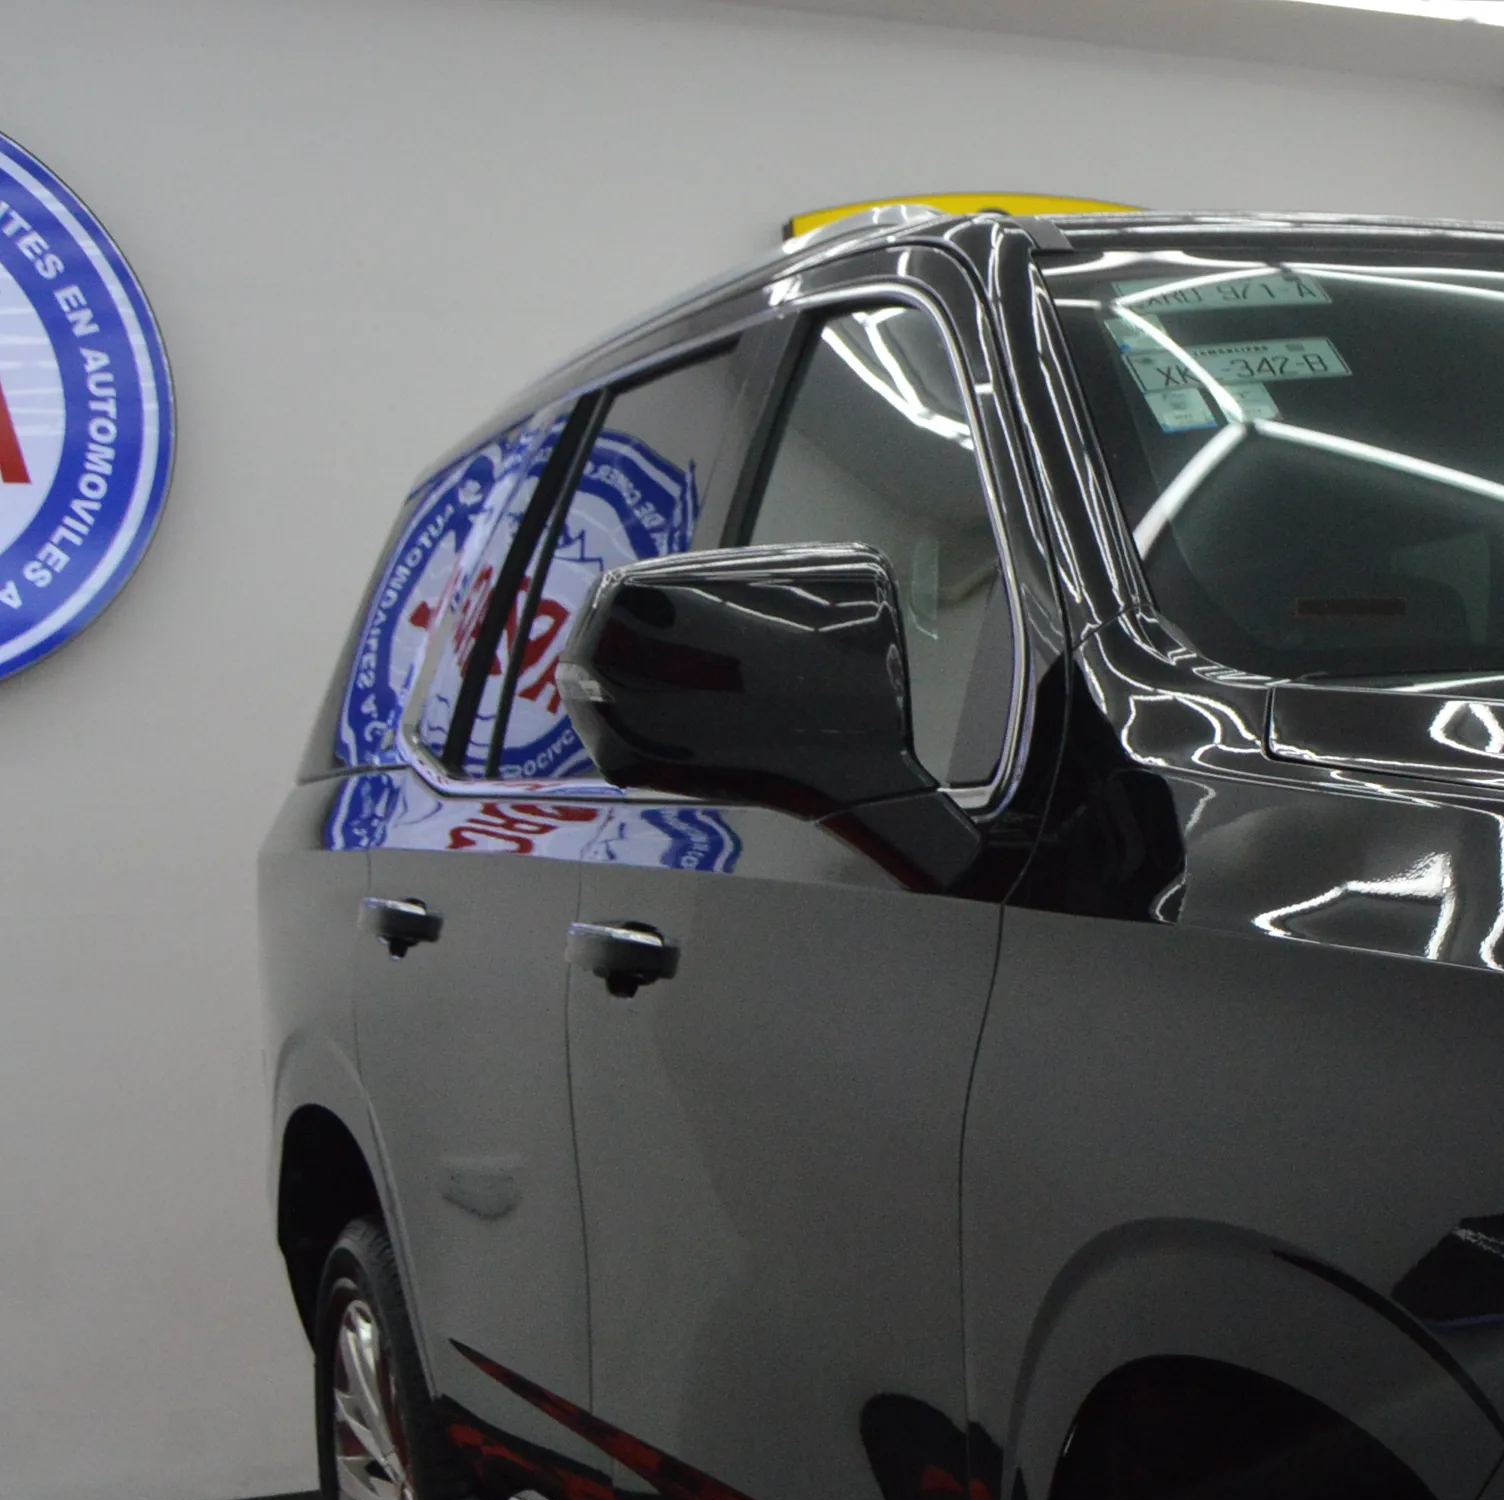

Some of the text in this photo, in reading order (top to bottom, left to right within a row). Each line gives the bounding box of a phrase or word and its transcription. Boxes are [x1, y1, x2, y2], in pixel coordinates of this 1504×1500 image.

[0, 200, 65, 280] TES
[53, 284, 99, 337] EN
[1156, 353, 1329, 386] XK-342-B
[23, 346, 119, 589] AUTOMOVILES
